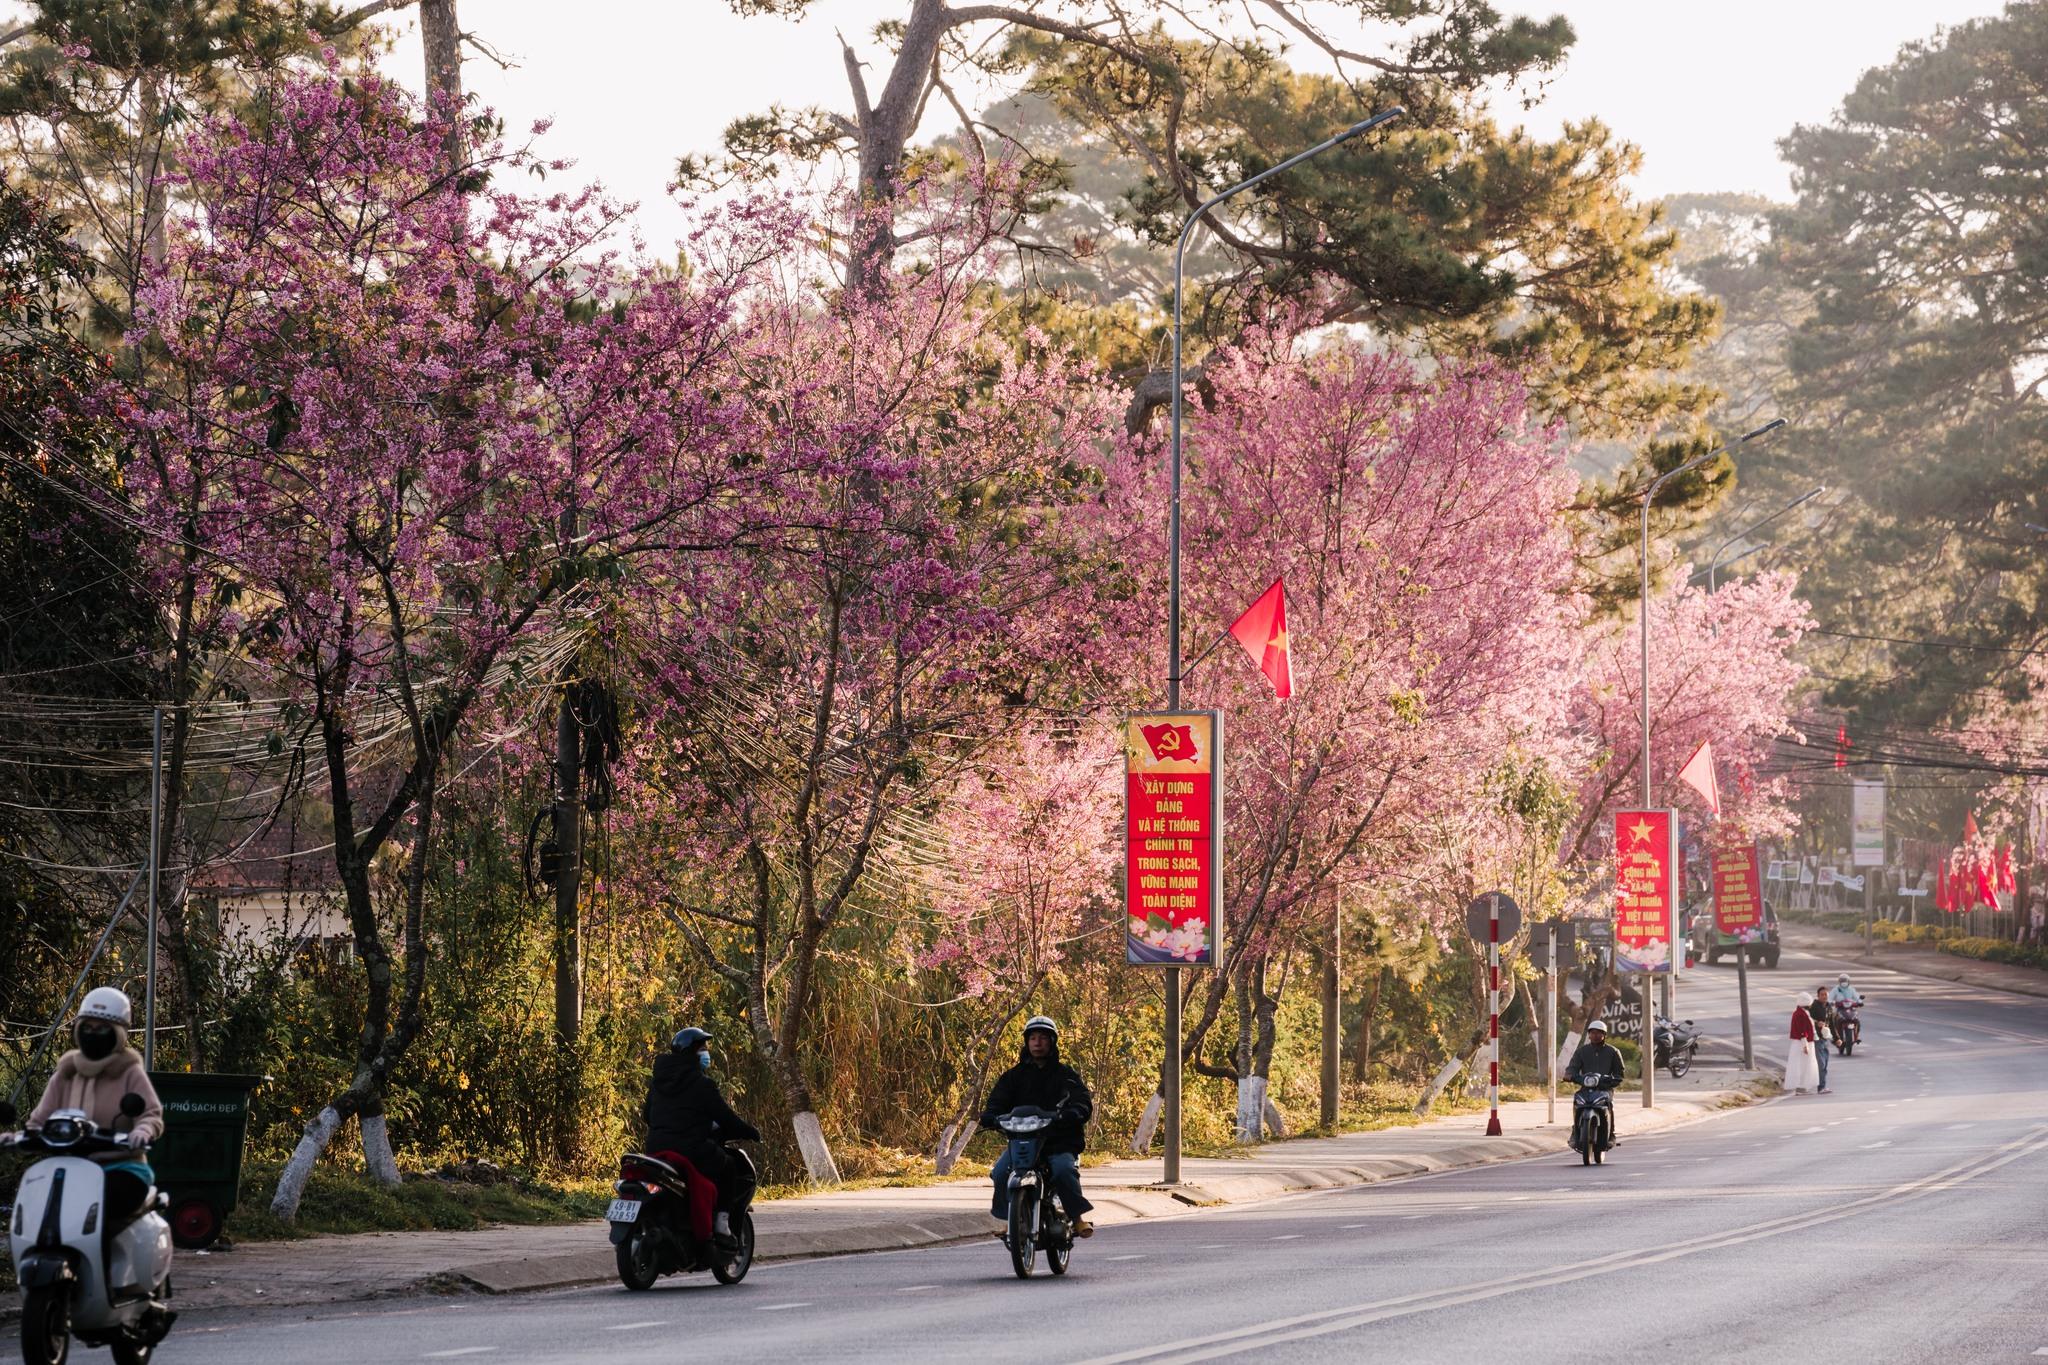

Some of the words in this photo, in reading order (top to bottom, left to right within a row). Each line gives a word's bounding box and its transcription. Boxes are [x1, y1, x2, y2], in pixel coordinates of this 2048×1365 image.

[1146, 779, 1164, 794] XÂY
[1168, 781, 1194, 796] DỰNG
[1156, 797, 1183, 813] ĐẢNG
[1138, 817, 1151, 832] VÀ
[1153, 817, 1166, 834] HỆ
[1168, 816, 1200, 832] THỐNG
[1145, 837, 1175, 851] CHÍNH
[1177, 839, 1192, 853] TRỊ
[1137, 857, 1169, 870] TRONG
[1172, 857, 1200, 872] SẠCH,
[1140, 874, 1166, 889] VỮNG
[1169, 876, 1198, 891] MẠNH
[1142, 893, 1167, 908] TOÀN
[1170, 893, 1196, 910] DIỆN!
